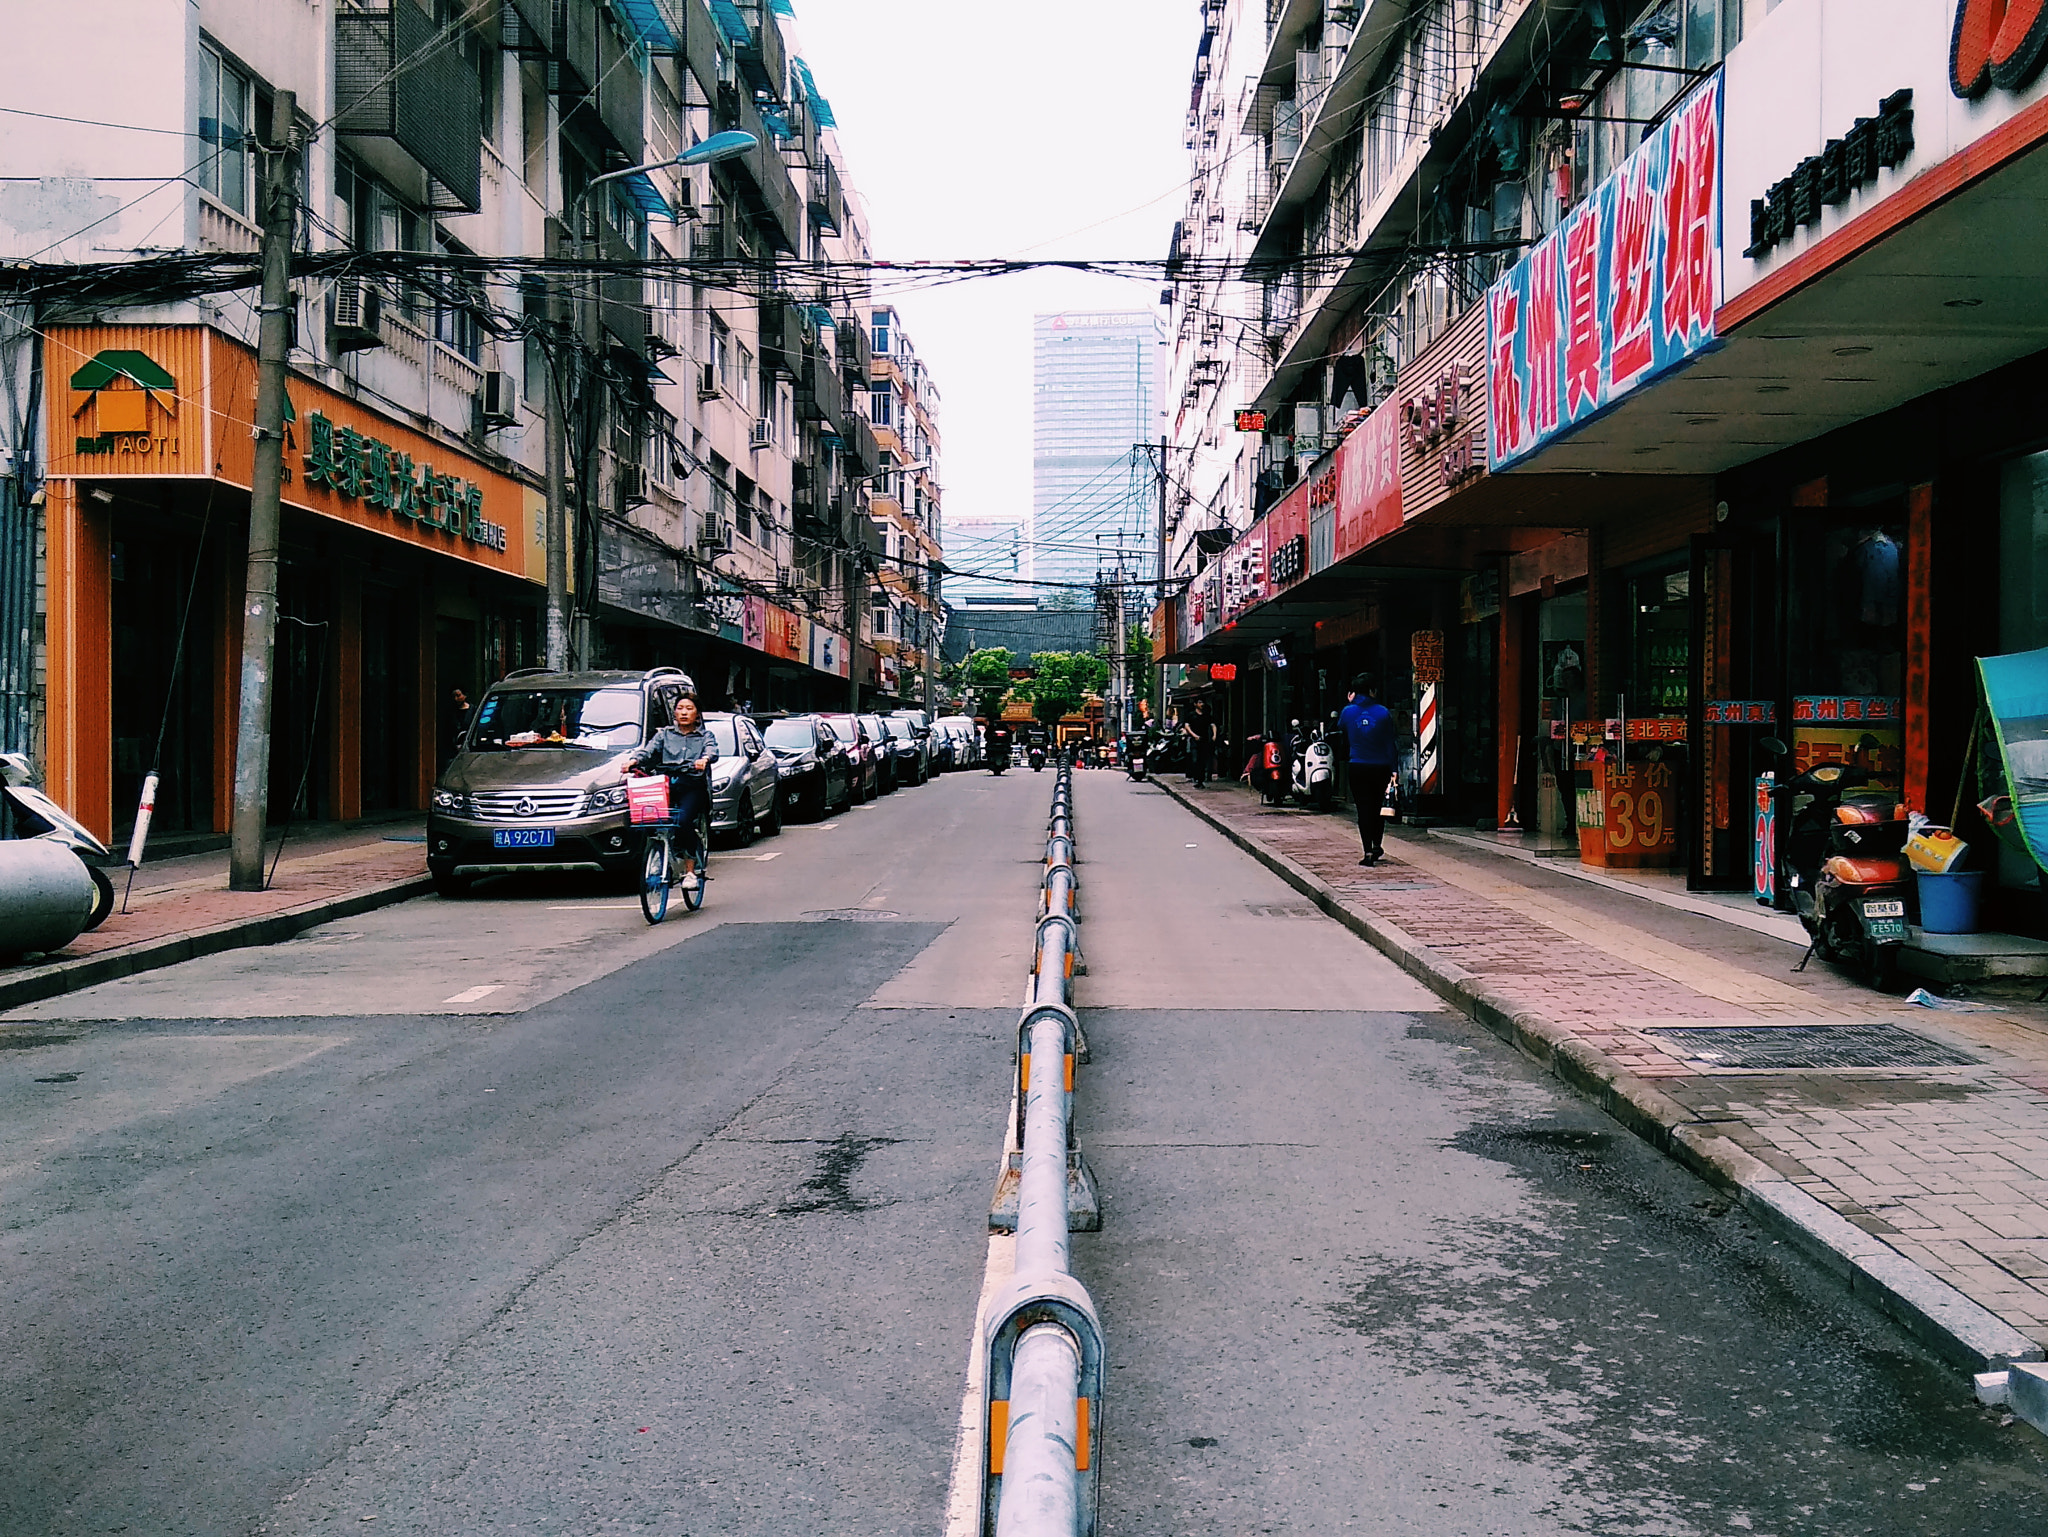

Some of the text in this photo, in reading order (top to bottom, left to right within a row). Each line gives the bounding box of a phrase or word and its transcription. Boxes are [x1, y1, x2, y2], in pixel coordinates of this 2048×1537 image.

[1490, 85, 1717, 463] 杭州真丝绸
[1238, 412, 1265, 430] 住宿
[121, 437, 179, 453] AOTI
[308, 408, 484, 542] 奥泰甄选生活馆
[1606, 763, 1673, 788] 特价
